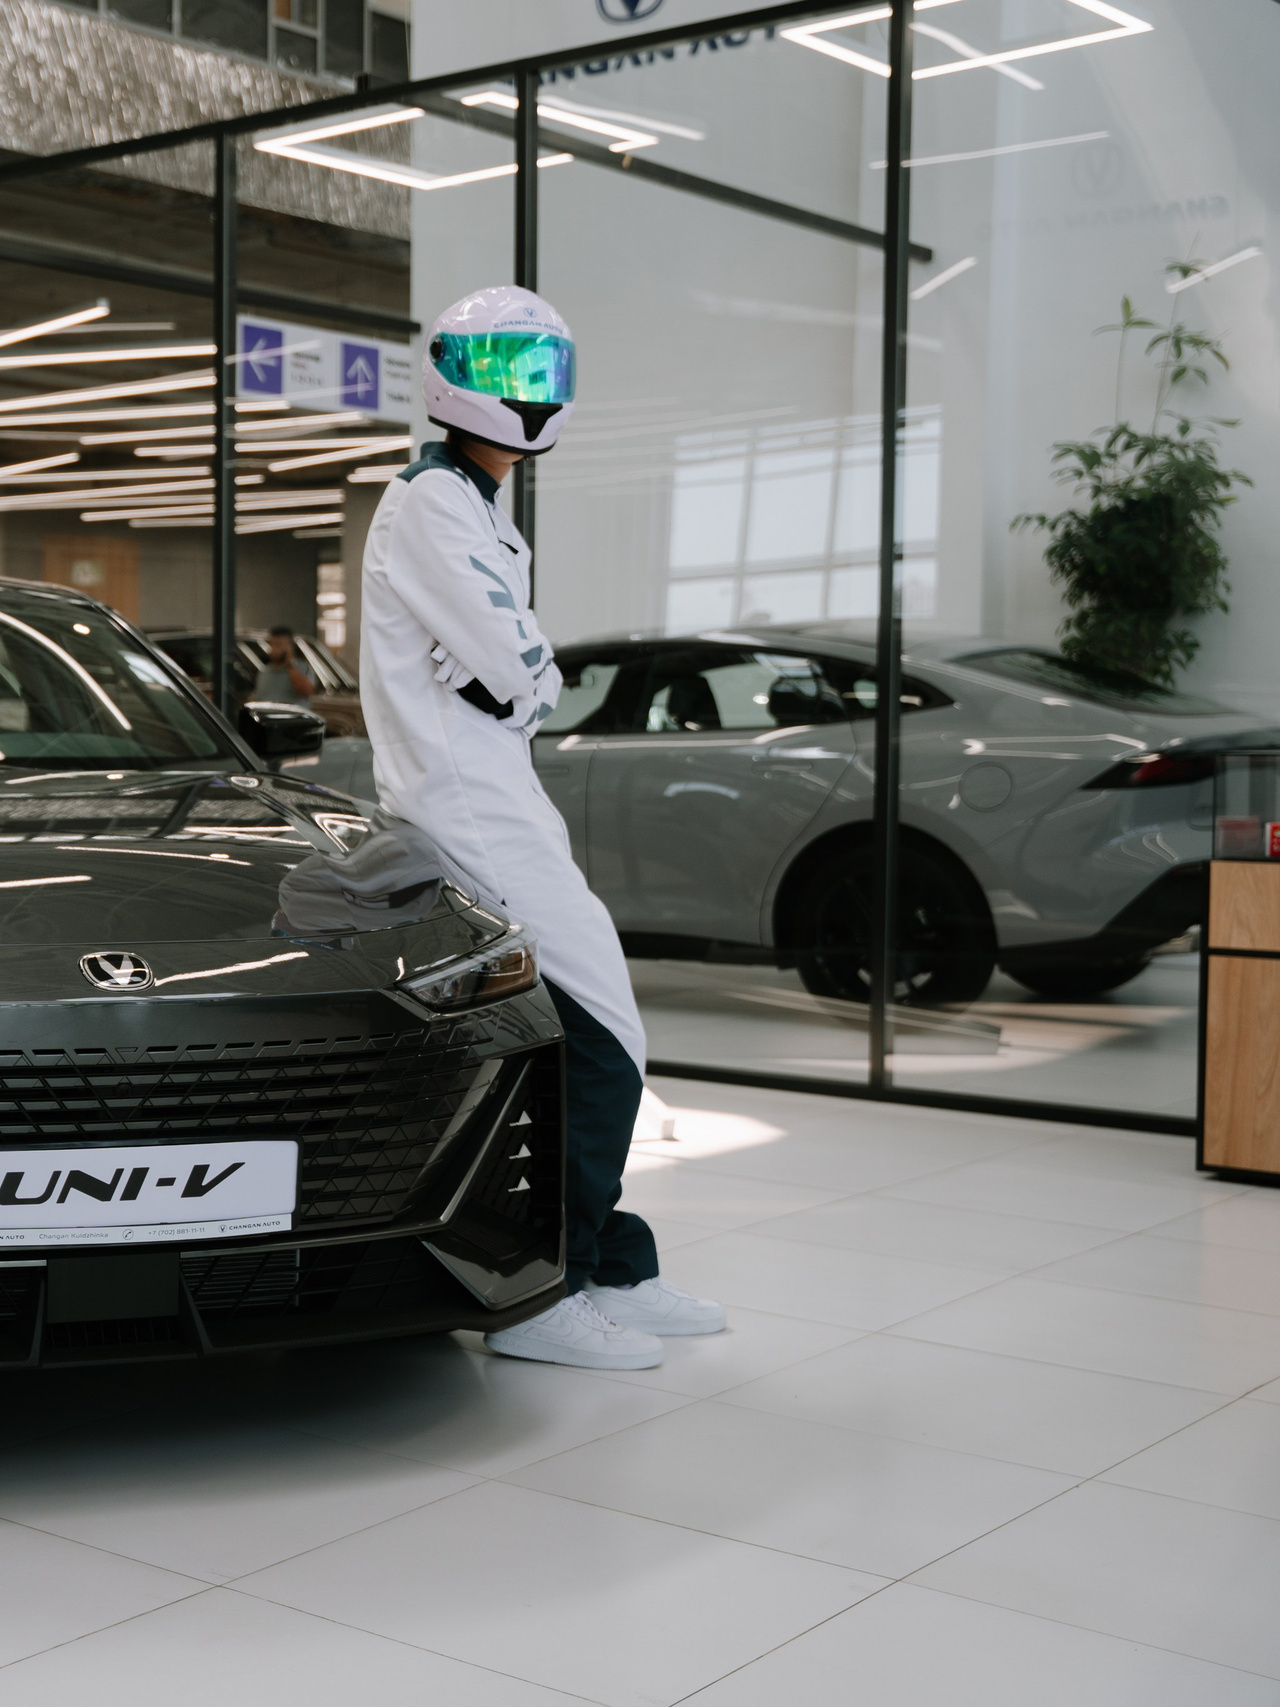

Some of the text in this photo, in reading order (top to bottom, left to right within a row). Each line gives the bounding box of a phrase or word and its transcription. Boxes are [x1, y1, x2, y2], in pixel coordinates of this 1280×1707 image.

[493, 320, 563, 334] CHANGAN AUTO
[38, 1233, 69, 1241] Changan
[158, 1229, 175, 1237] (702)
[176, 1227, 205, 1235] 881-11-11
